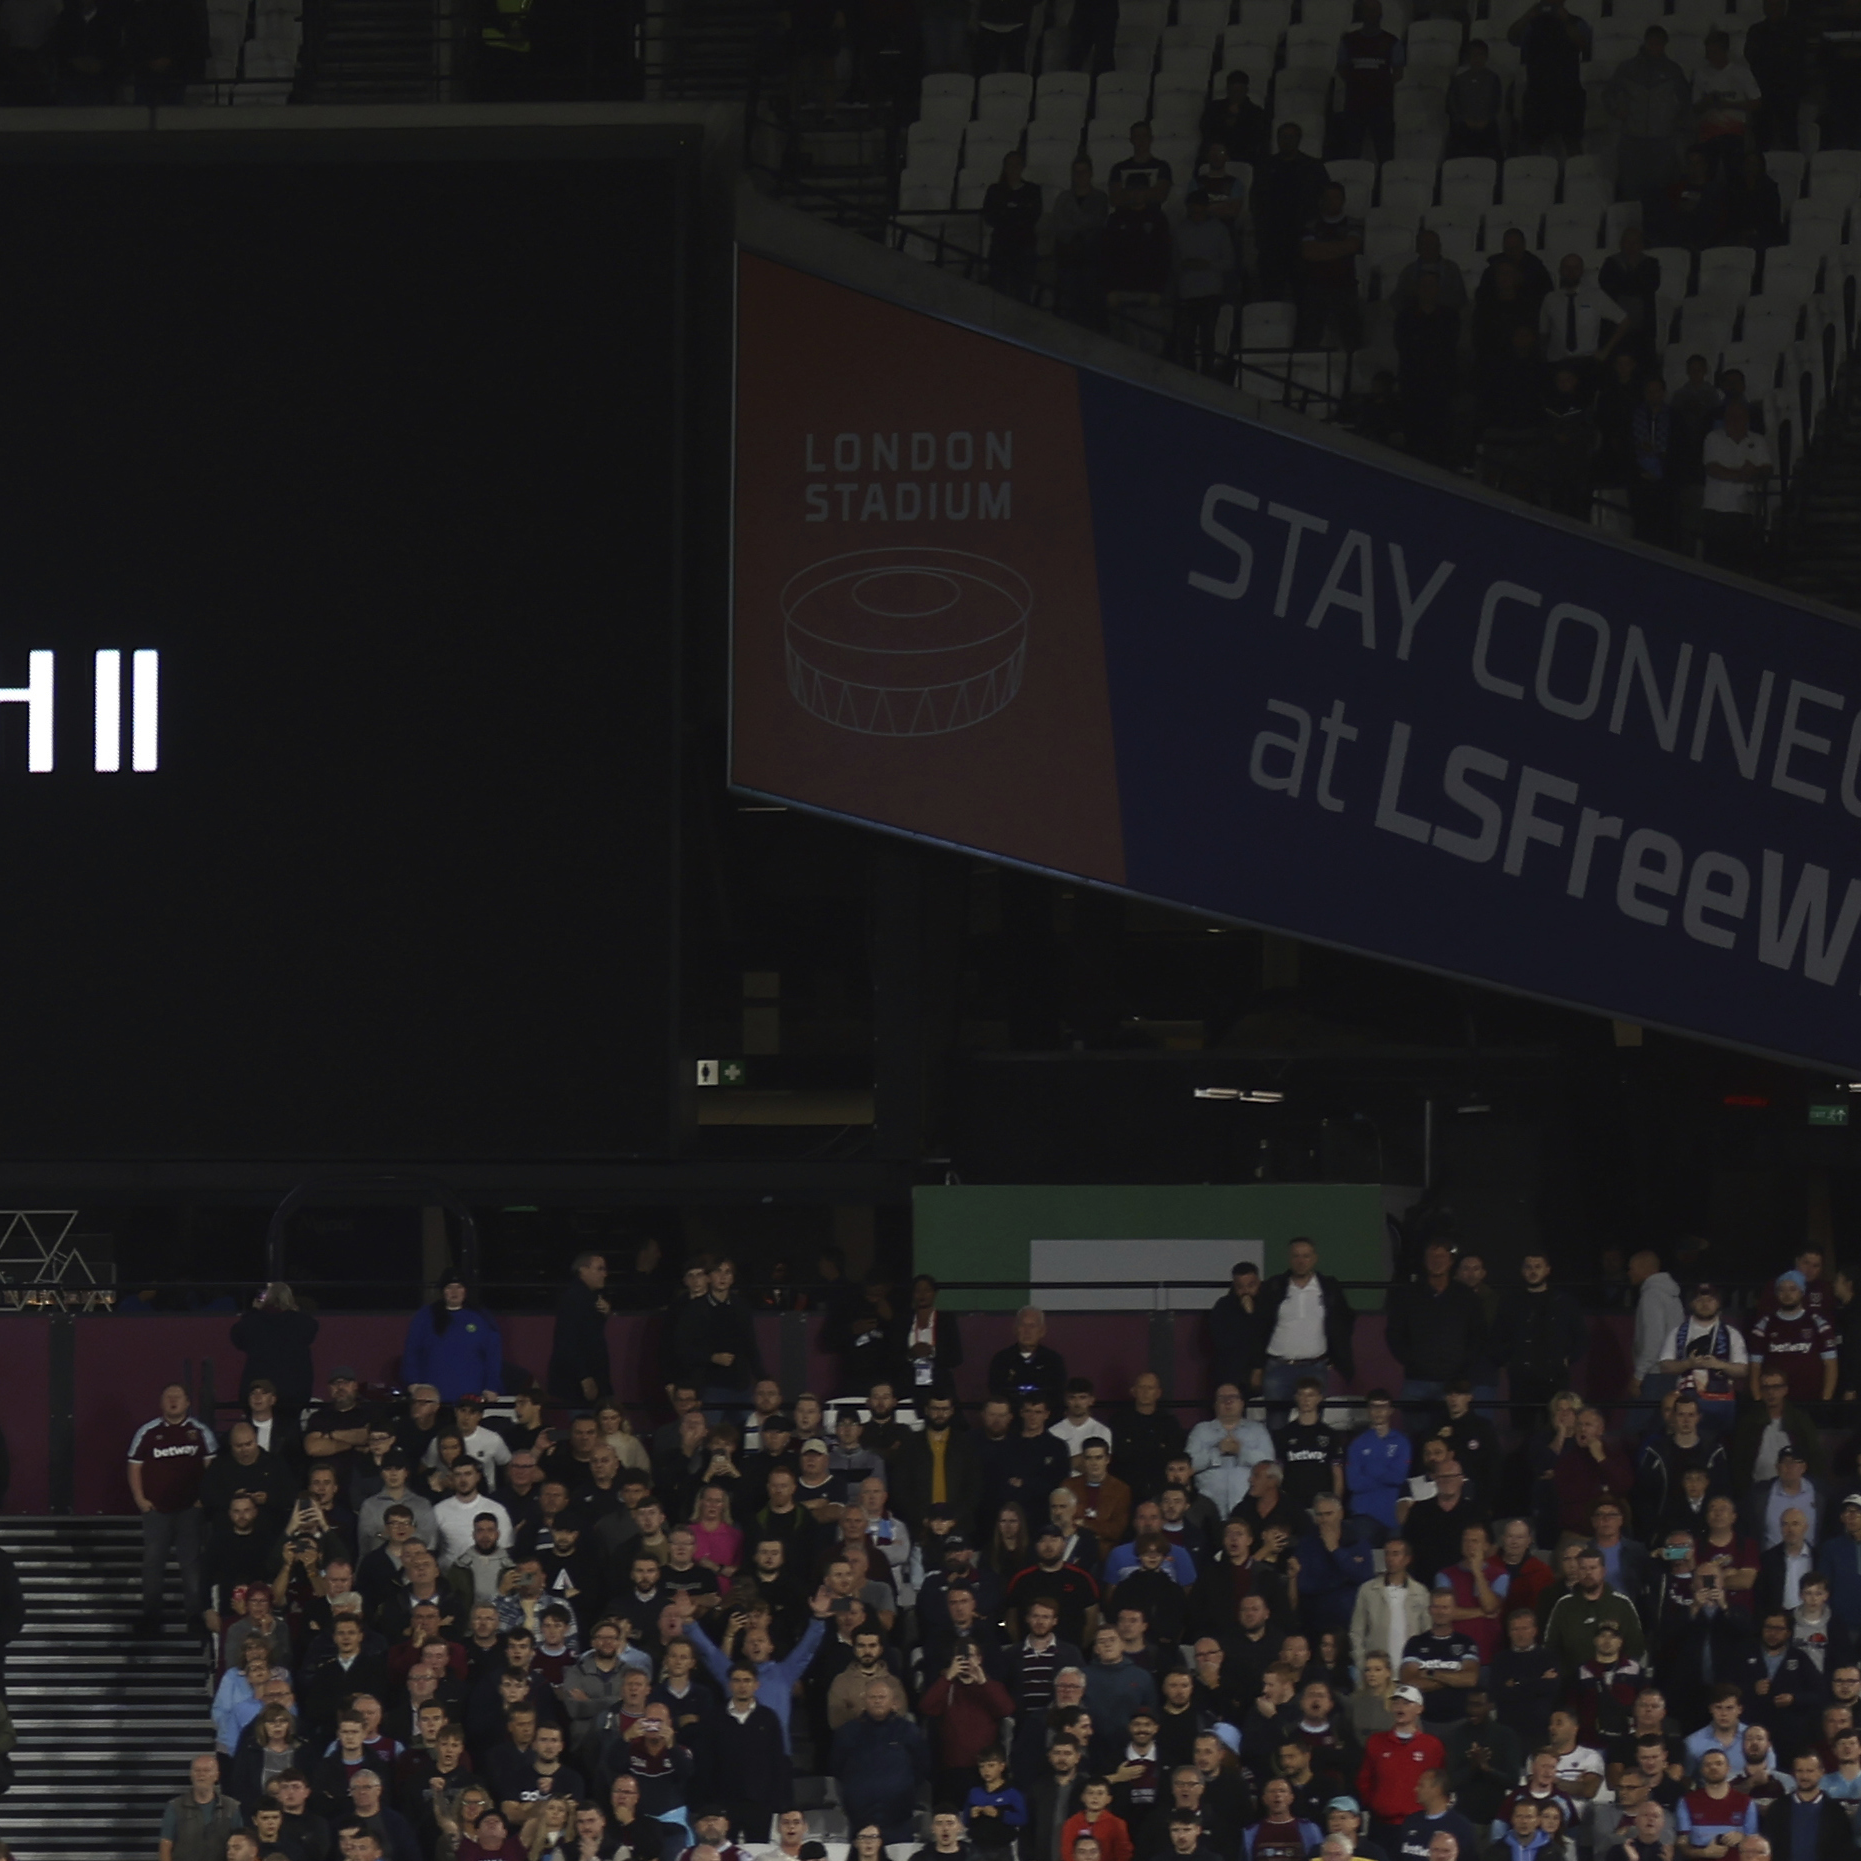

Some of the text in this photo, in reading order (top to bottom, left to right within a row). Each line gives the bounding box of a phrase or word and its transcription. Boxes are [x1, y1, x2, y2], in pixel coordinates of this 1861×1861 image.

[804, 430, 1015, 472] LONDON
[804, 482, 1013, 523] STADIUM
[1188, 483, 1861, 820] STAY CONNE
[95, 650, 158, 772] II
[1248, 698, 1359, 813] at
[154, 1444, 197, 1459] betway
